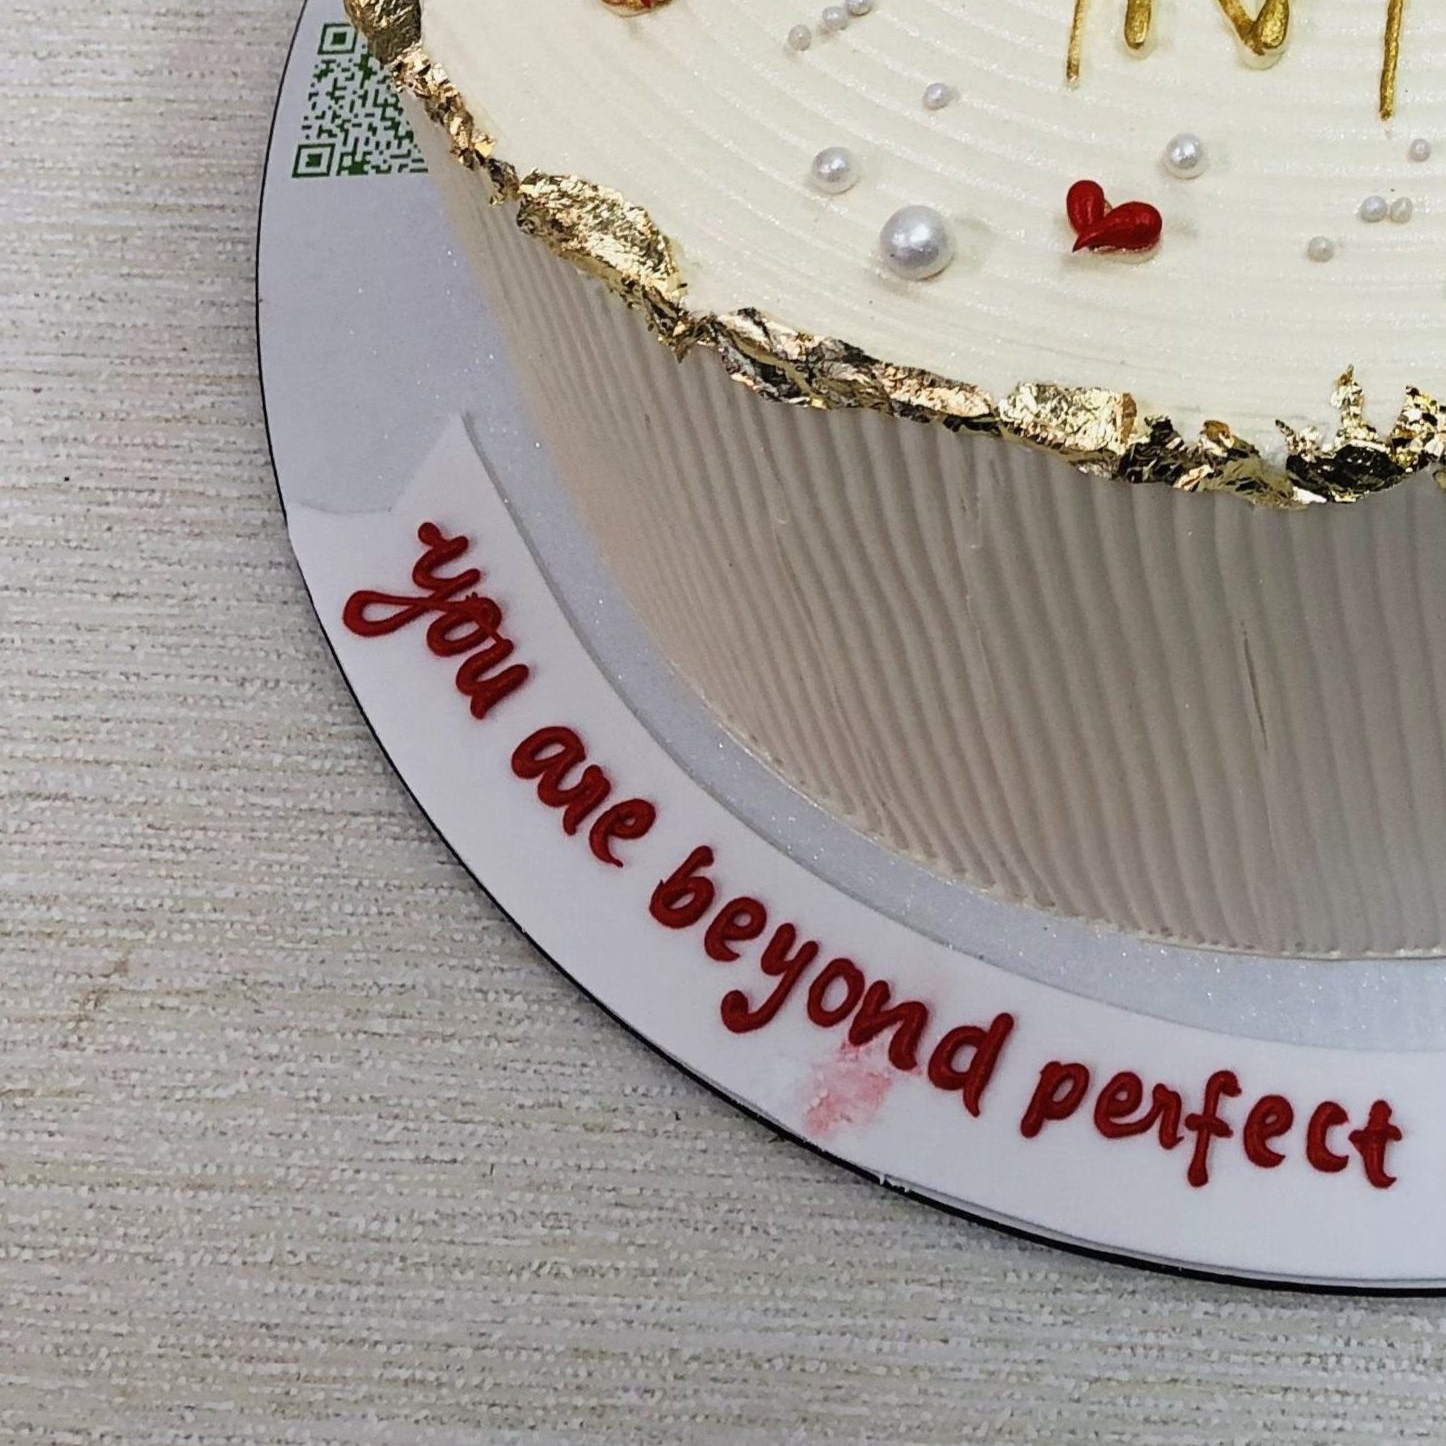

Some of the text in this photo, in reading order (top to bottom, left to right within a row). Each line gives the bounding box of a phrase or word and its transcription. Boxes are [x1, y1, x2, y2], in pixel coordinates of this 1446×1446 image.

[342, 521, 530, 721] you
[509, 725, 658, 869] are
[648, 844, 1016, 1118] beyond
